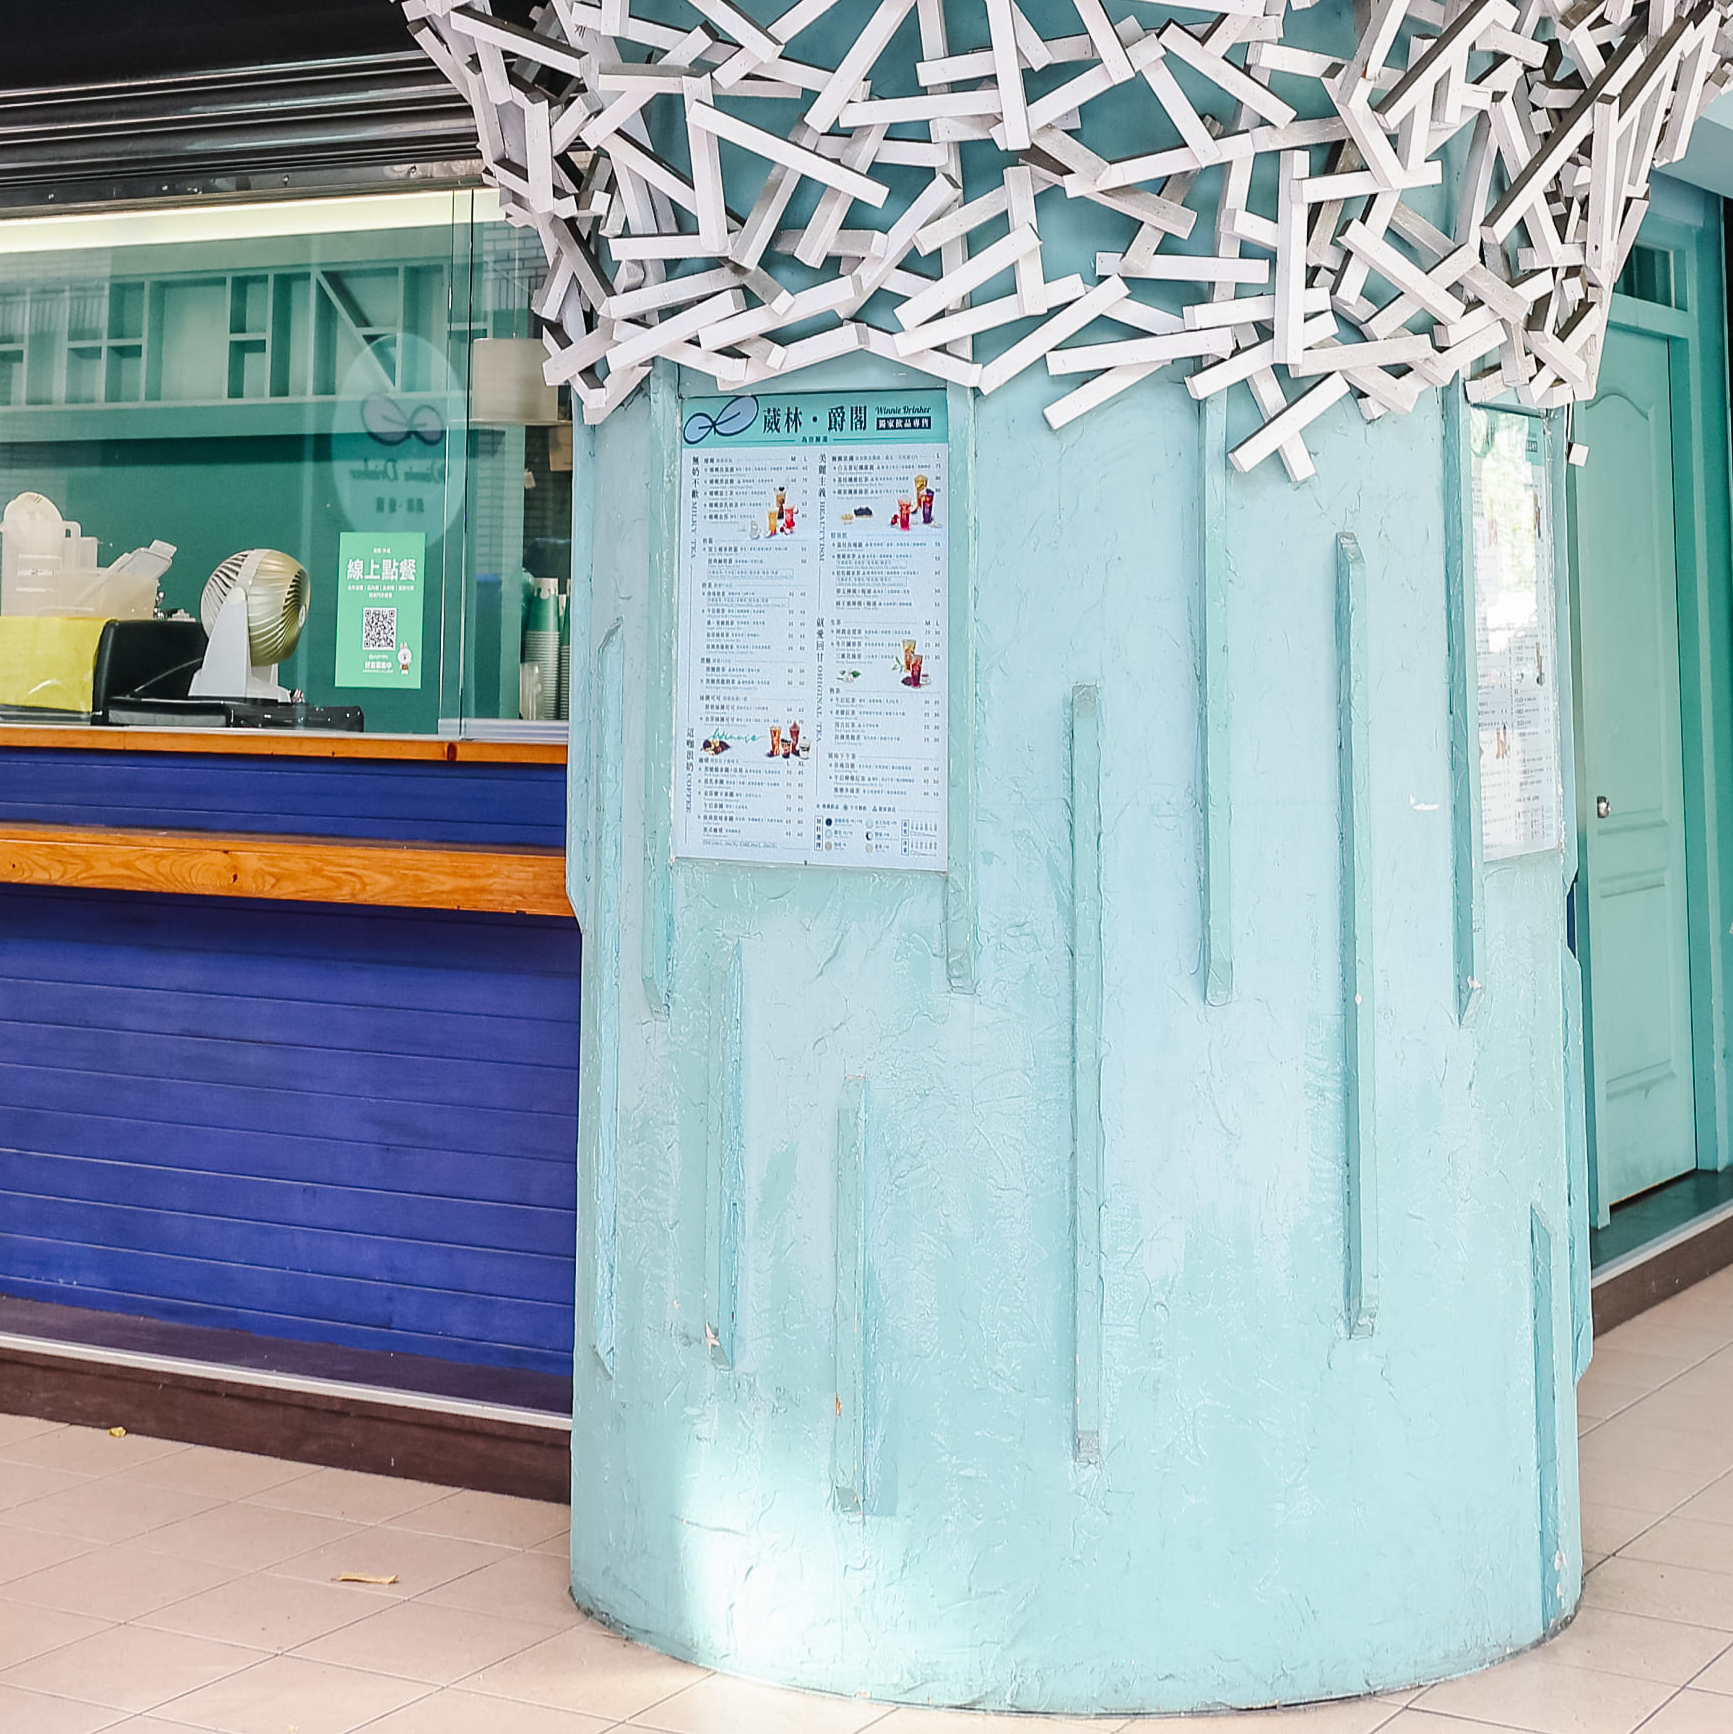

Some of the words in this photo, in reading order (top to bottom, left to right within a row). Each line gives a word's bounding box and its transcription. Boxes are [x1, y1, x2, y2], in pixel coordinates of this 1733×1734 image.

[875, 406, 901, 416] Winnie
[903, 405, 932, 415] Drinker
[347, 559, 416, 581] 線上點餐
